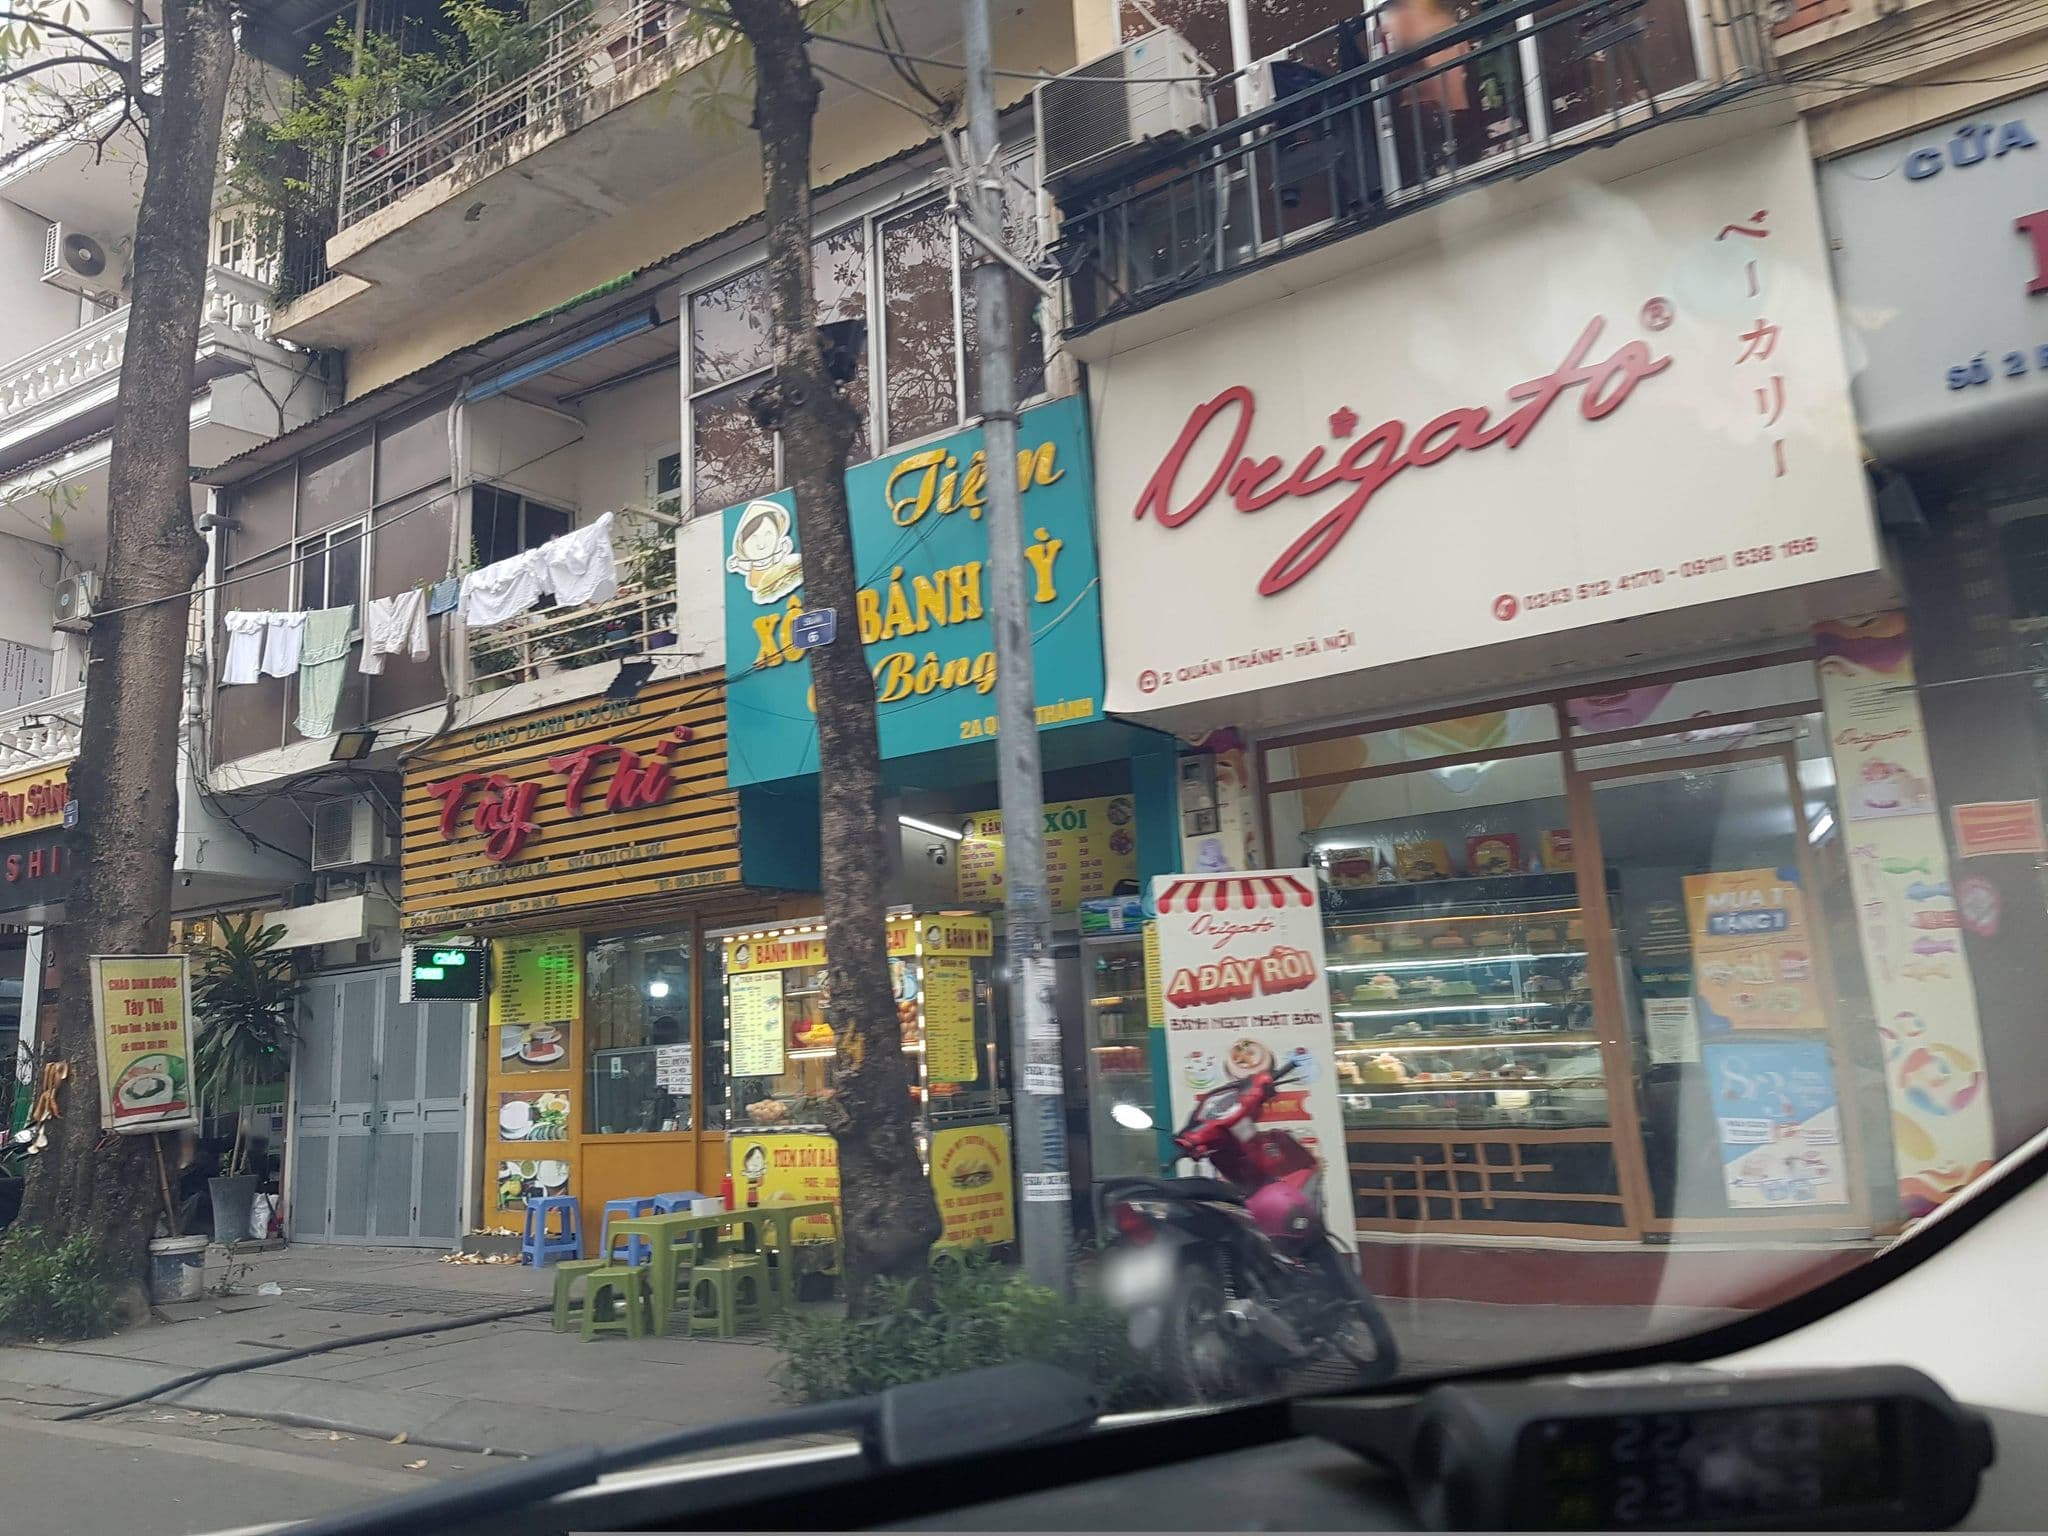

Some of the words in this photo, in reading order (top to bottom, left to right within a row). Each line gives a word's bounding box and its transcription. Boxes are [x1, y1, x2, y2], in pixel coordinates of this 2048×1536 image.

[1714, 209, 1787, 478] ベーカリー
[1134, 314, 1673, 597] Origato
[752, 594, 806, 669] XÔ
[857, 561, 983, 644] BÁNH
[807, 630, 820, 643] 6
[873, 652, 997, 703] Bông
[1162, 671, 1173, 686] 2
[1175, 657, 1223, 682] QUÁN
[1226, 648, 1284, 671] THÁNH
[1294, 636, 1320, 658] HÀ
[1323, 629, 1356, 653] NỘI
[26, 779, 70, 816] SÁN
[426, 773, 543, 862] Tây
[547, 740, 678, 817] Thi
[1043, 805, 1087, 833] XÔI
[755, 942, 788, 965] BÁNH
[1189, 914, 1276, 950] Origato
[1169, 968, 1193, 996] A
[1198, 956, 1257, 992] ĐÂY
[1261, 946, 1315, 982] RỒI
[124, 999, 144, 1017] Tây
[146, 998, 164, 1014] Thi
